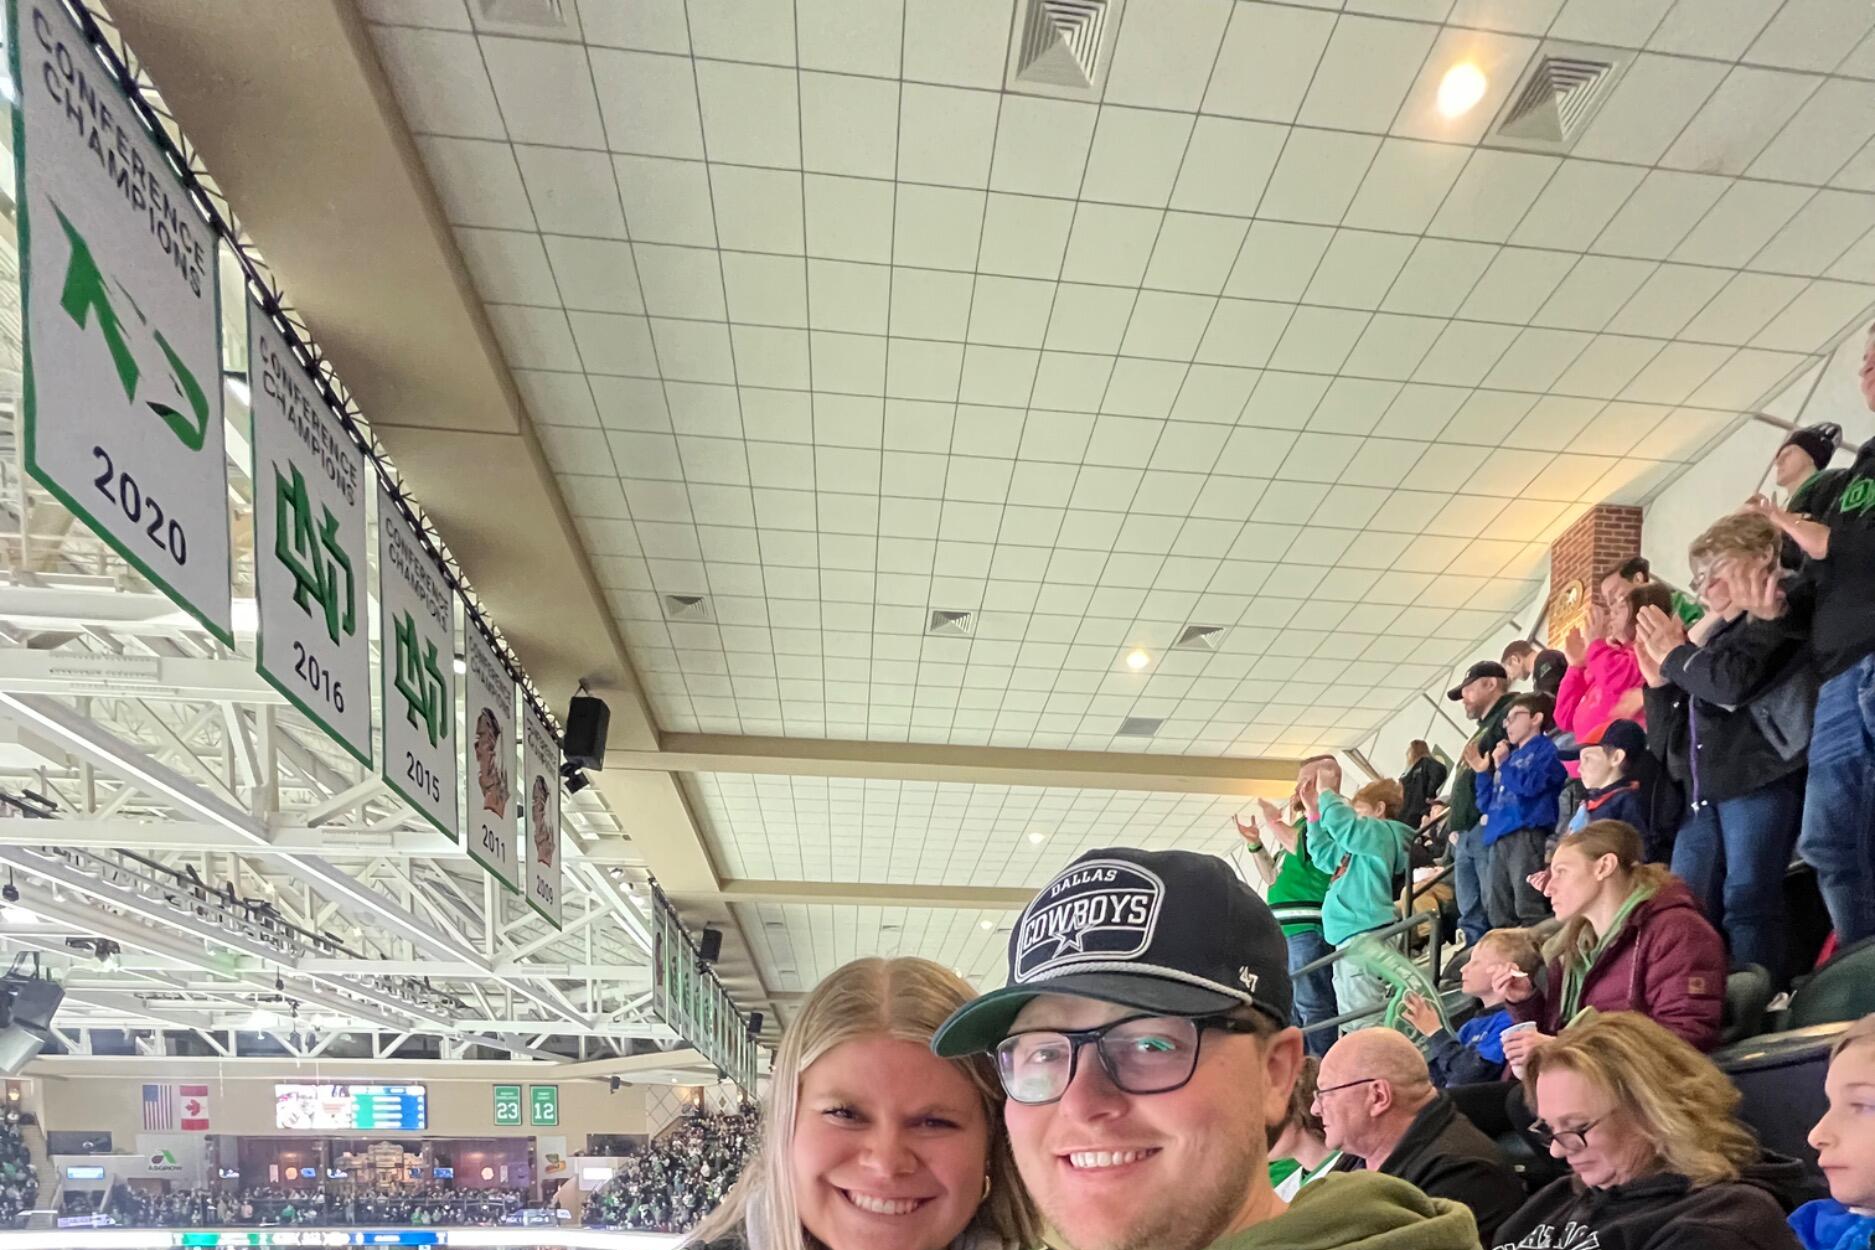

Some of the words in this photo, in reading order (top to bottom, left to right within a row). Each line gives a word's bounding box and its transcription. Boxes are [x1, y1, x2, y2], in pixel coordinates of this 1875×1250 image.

[33, 7, 205, 276] CONFERENCE
[43, 60, 201, 299] CHAMPIONS
[260, 335, 358, 488] CONFERENCE
[263, 370, 355, 507] CHAMPIONS
[93, 445, 187, 566] 2020
[294, 640, 344, 713] 2016
[406, 751, 440, 803] 2015
[482, 824, 506, 864] 2011
[1051, 869, 1118, 898] DALLAS
[1022, 894, 1149, 951] COWBOYS
[497, 1103, 518, 1119] 23
[534, 1103, 554, 1119] 12
